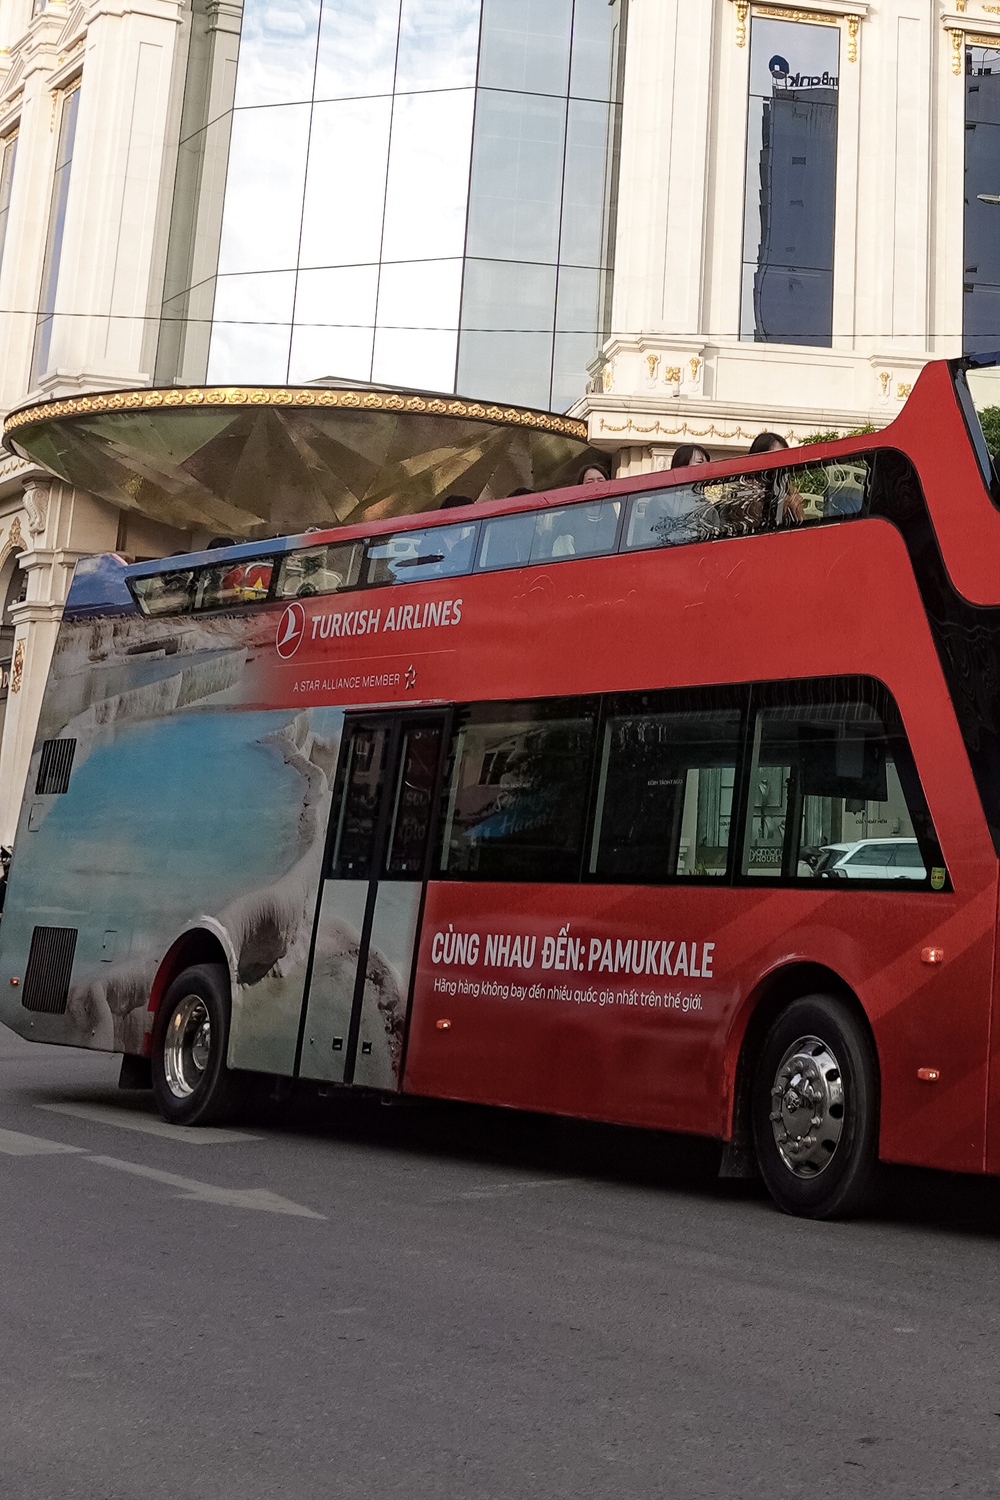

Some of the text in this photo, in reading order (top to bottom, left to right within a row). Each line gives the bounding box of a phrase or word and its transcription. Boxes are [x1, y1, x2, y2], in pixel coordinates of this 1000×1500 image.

[310, 598, 463, 640] TURKISH AIRLINES
[293, 673, 400, 692] A STAR ALLIANCE MEMBER
[431, 923, 716, 978] CÙNG NHAU ĐẾN: PAMUKKALE
[434, 977, 703, 1012] Hãng hàng không bay đến nhiều quốc gia nhất trên thế giới.
